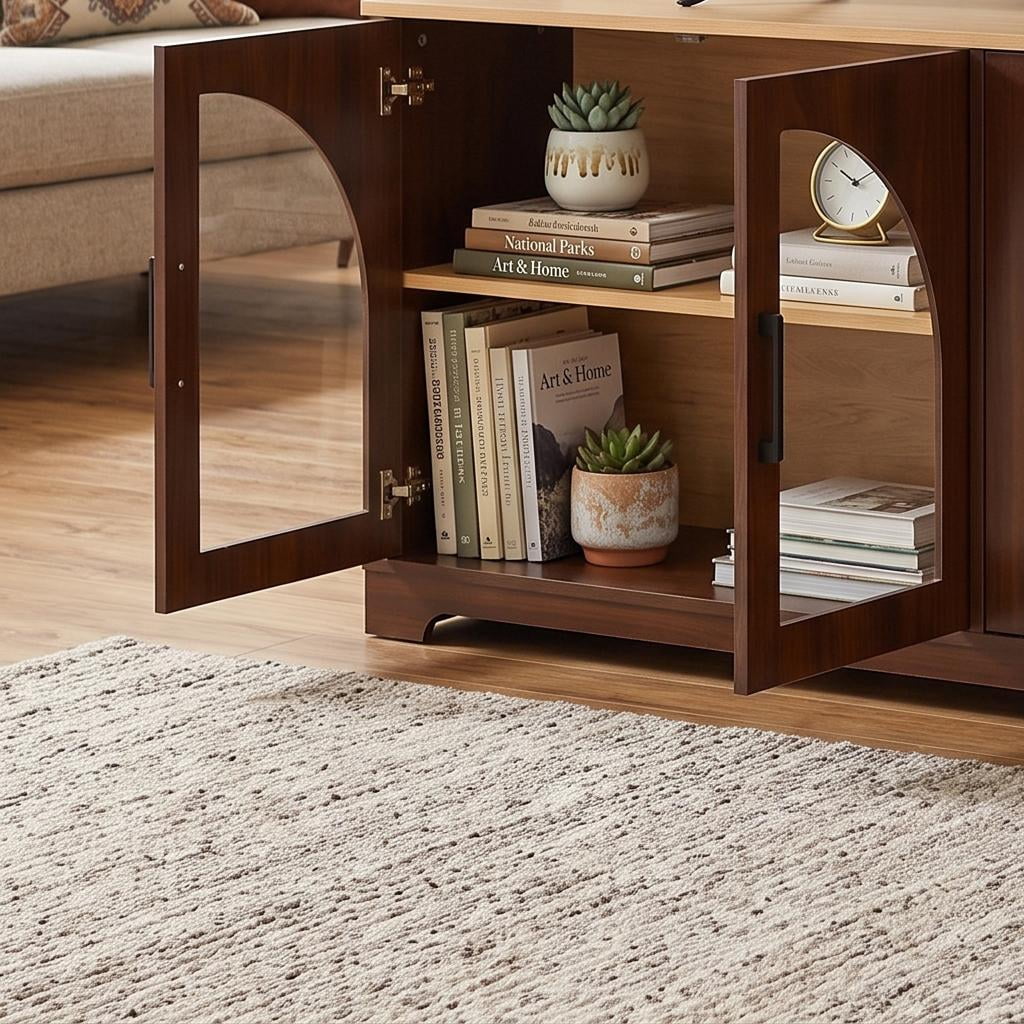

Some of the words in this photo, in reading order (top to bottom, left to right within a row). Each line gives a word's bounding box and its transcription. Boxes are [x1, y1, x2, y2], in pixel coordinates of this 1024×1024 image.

[505, 235, 556, 252] National
[560, 239, 595, 257] Parks
[493, 257, 514, 273] Art
[516, 259, 528, 274] &
[530, 260, 570, 278] Home
[540, 373, 560, 390] Art
[562, 368, 573, 385] &
[575, 364, 612, 382] Home
